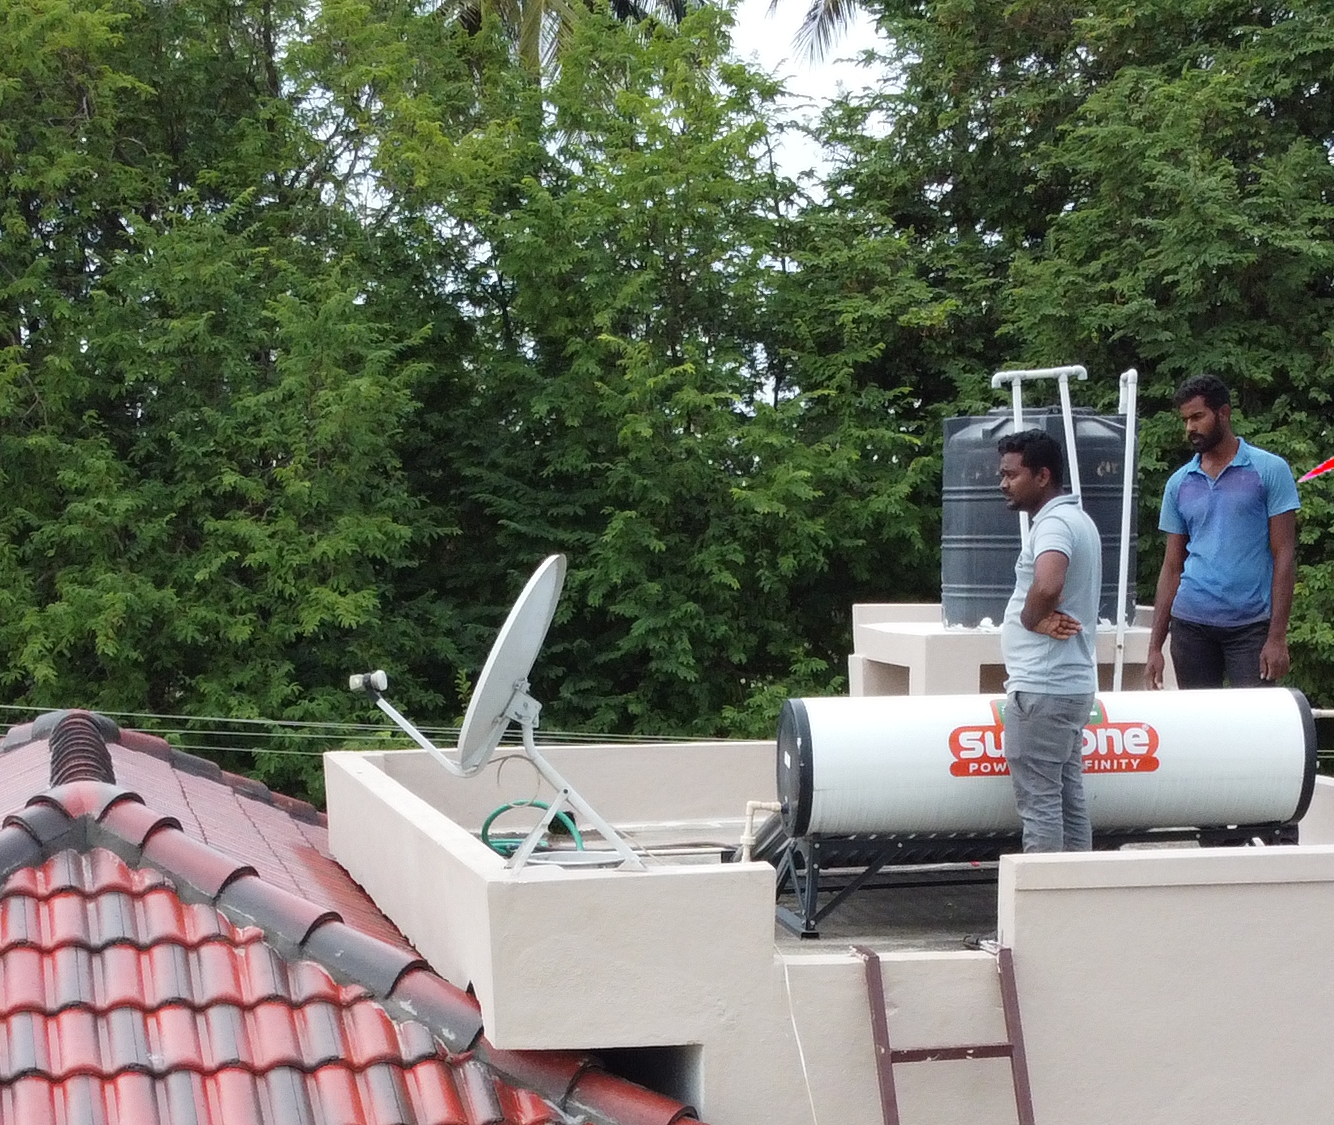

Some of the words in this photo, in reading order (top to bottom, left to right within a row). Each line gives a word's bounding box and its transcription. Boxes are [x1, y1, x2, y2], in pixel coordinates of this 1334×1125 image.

[958, 728, 1150, 759] suone
[968, 762, 1007, 774] POW
[1084, 759, 1141, 770] FINITY
